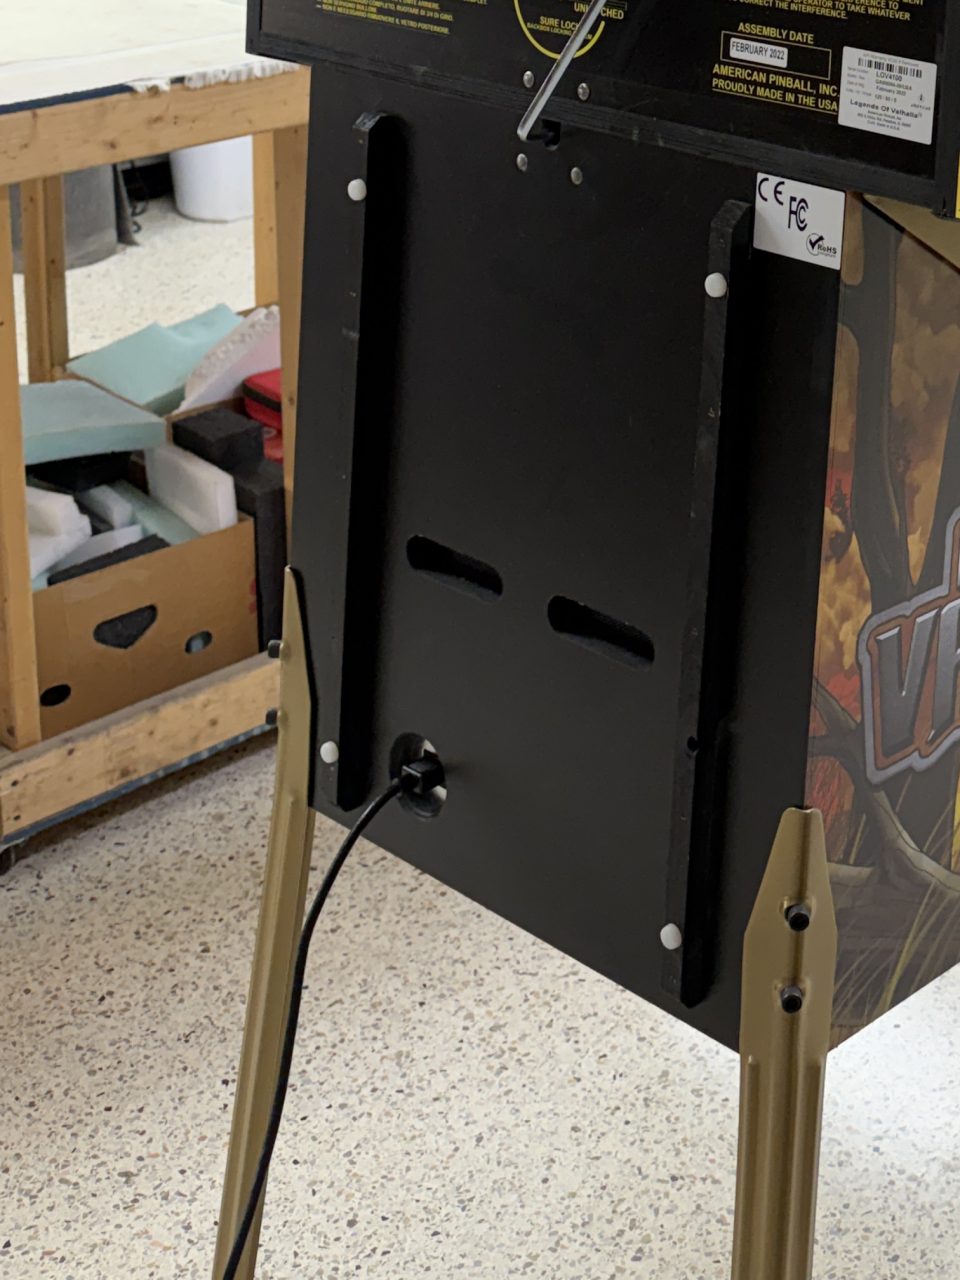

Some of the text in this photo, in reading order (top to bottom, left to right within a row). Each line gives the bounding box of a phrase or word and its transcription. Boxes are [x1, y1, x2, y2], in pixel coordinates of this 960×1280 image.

[574, 2, 624, 20] UNCHED
[775, 0, 789, 10] THE
[790, 2, 848, 19] INTERFERENCE.
[835, 0, 845, 10] TO
[847, 2, 866, 14] TAKE
[867, 6, 911, 20] WHATEVER
[888, 0, 899, 10] TO
[540, 16, 560, 28] SURE
[738, 22, 815, 44] ASSEMBLY DATE
[732, 41, 785, 60] FEBRUARY 2022
[713, 64, 767, 83] AMERICAN
[768, 72, 817, 94] PINBALL,
[818, 84, 840, 97] INC.
[712, 78, 838, 111] PROUDLY MADE IN THE USA
[850, 98, 879, 110] Legends
[881, 105, 890, 113] Of
[758, 177, 785, 206] CE
[817, 243, 837, 255] RoHS
